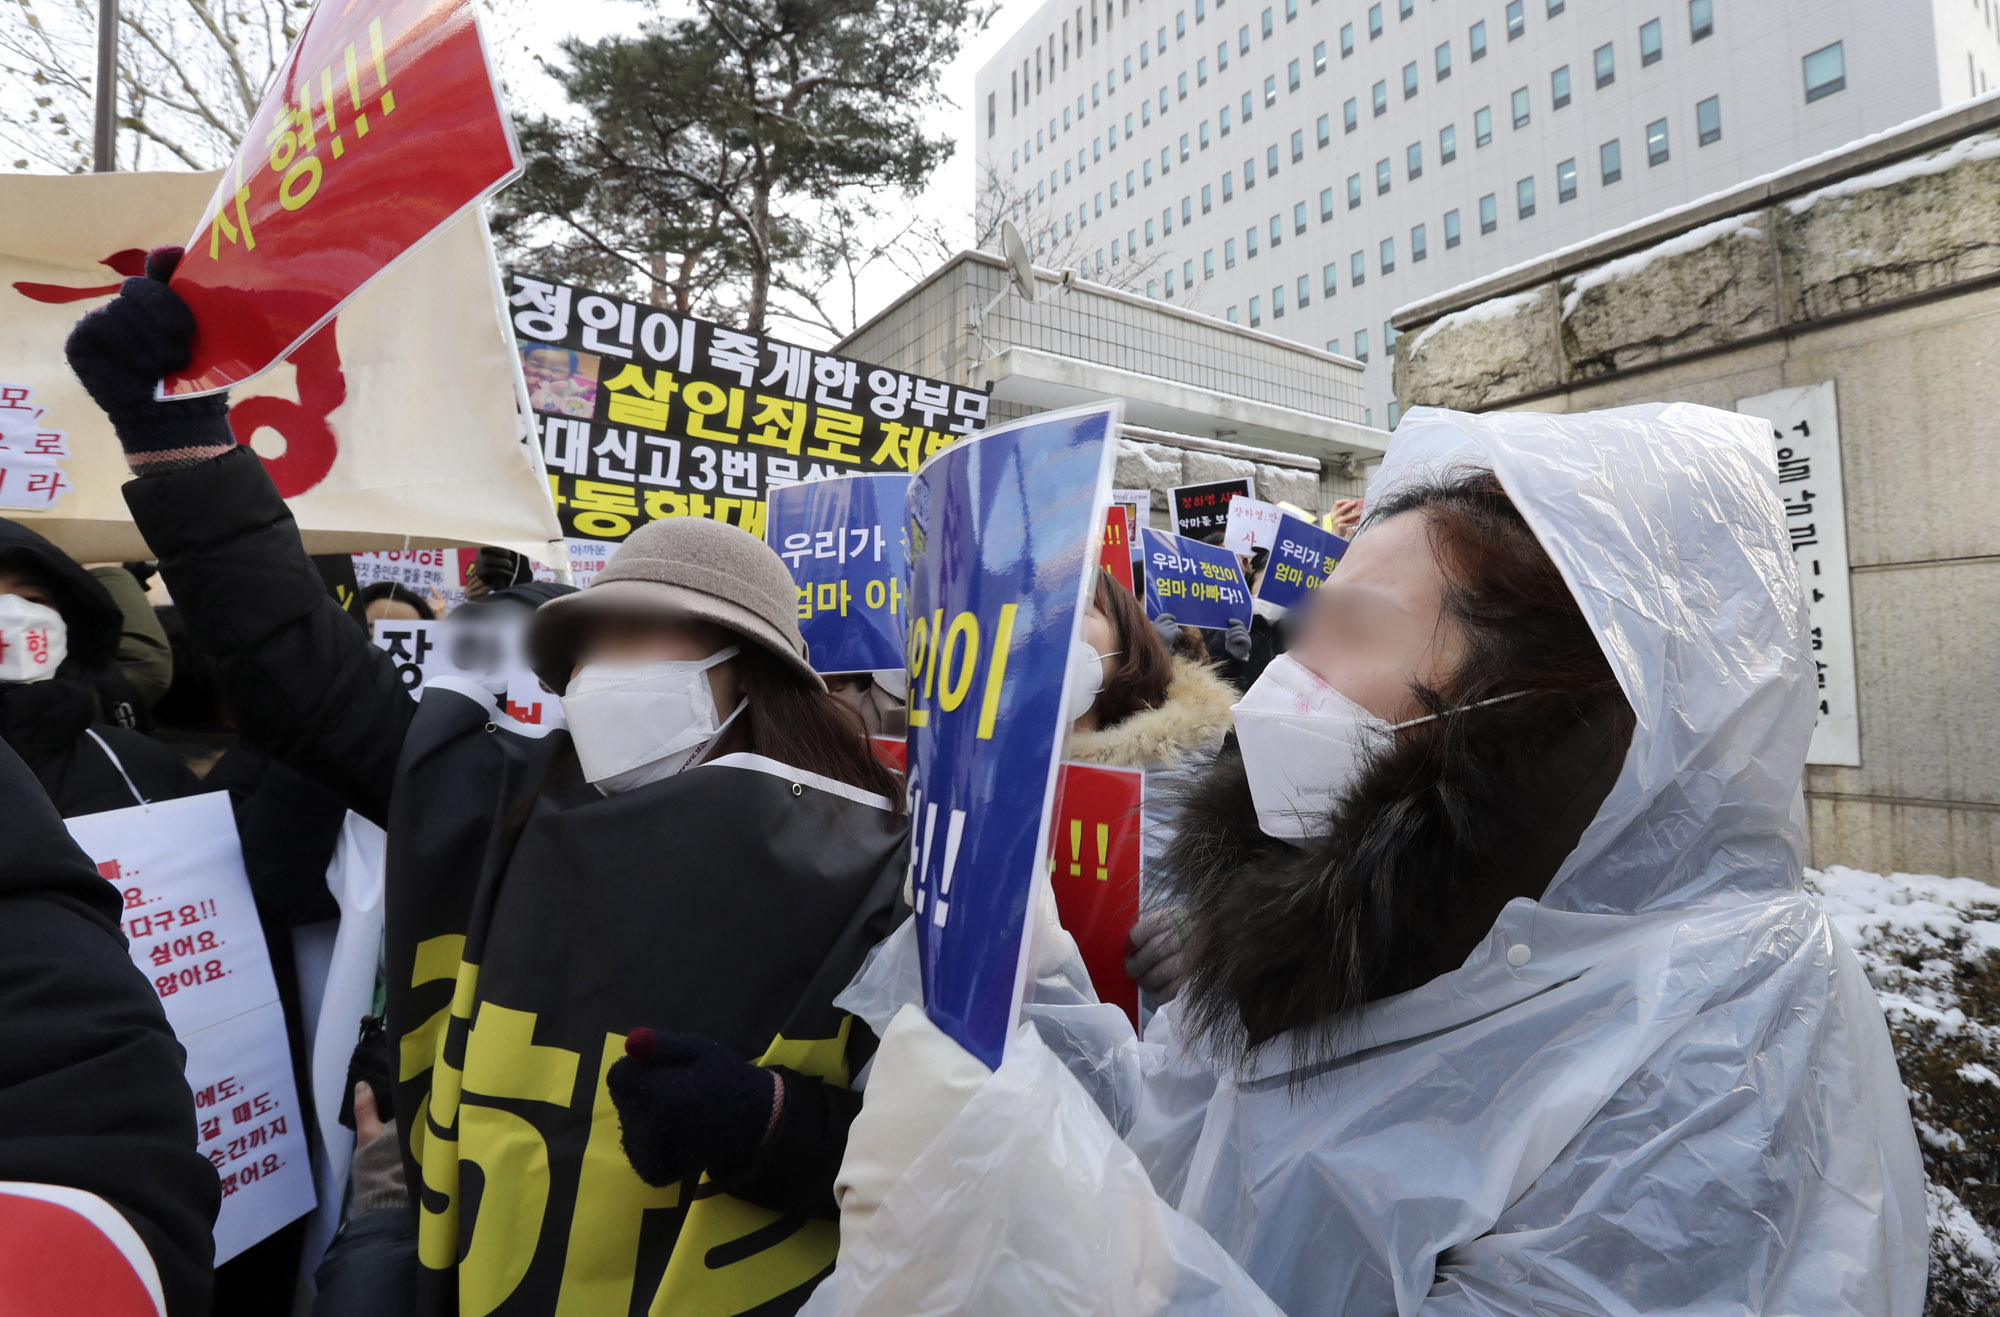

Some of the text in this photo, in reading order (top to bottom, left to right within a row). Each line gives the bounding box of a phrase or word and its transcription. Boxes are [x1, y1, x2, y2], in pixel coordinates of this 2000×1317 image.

[512, 275, 989, 434] 정인이 죽게한 양부모
[603, 363, 864, 464] 살인죄로
[689, 445, 758, 498] 3번
[781, 525, 886, 569] 우리가
[1280, 539, 1320, 569] 우리가
[1152, 552, 1239, 584] 우리가 정인이
[1274, 562, 1304, 587] 엄마
[1156, 577, 1245, 605] 엄마 아빠다!!
